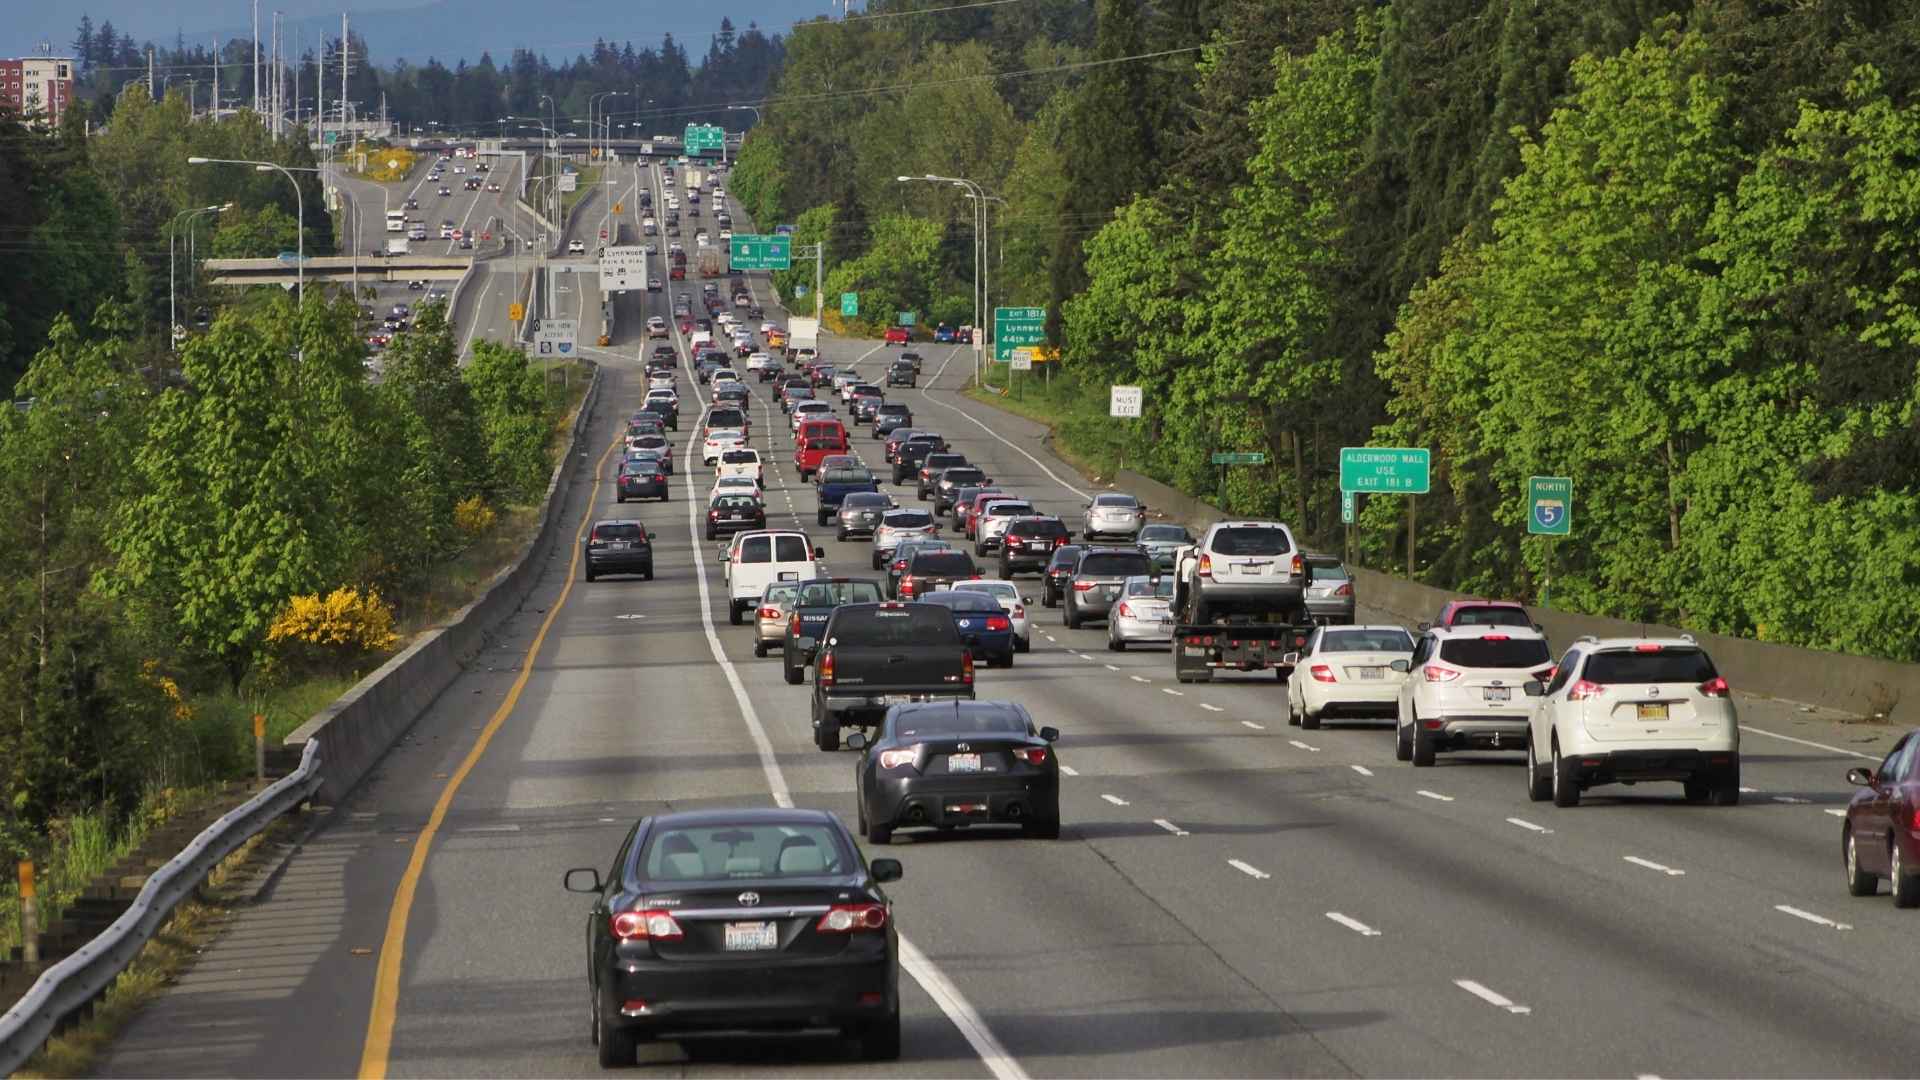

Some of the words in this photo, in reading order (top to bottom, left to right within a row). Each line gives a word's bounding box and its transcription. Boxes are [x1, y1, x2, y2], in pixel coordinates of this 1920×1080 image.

[1117, 405, 1134, 414] EXIT
[1346, 454, 1397, 463] ALDERWOOD
[1402, 455, 1424, 464] MALL
[1375, 466, 1395, 475] USE
[1357, 477, 1378, 487] EXIT
[1536, 482, 1566, 491] NORTH
[1544, 507, 1554, 521] 5
